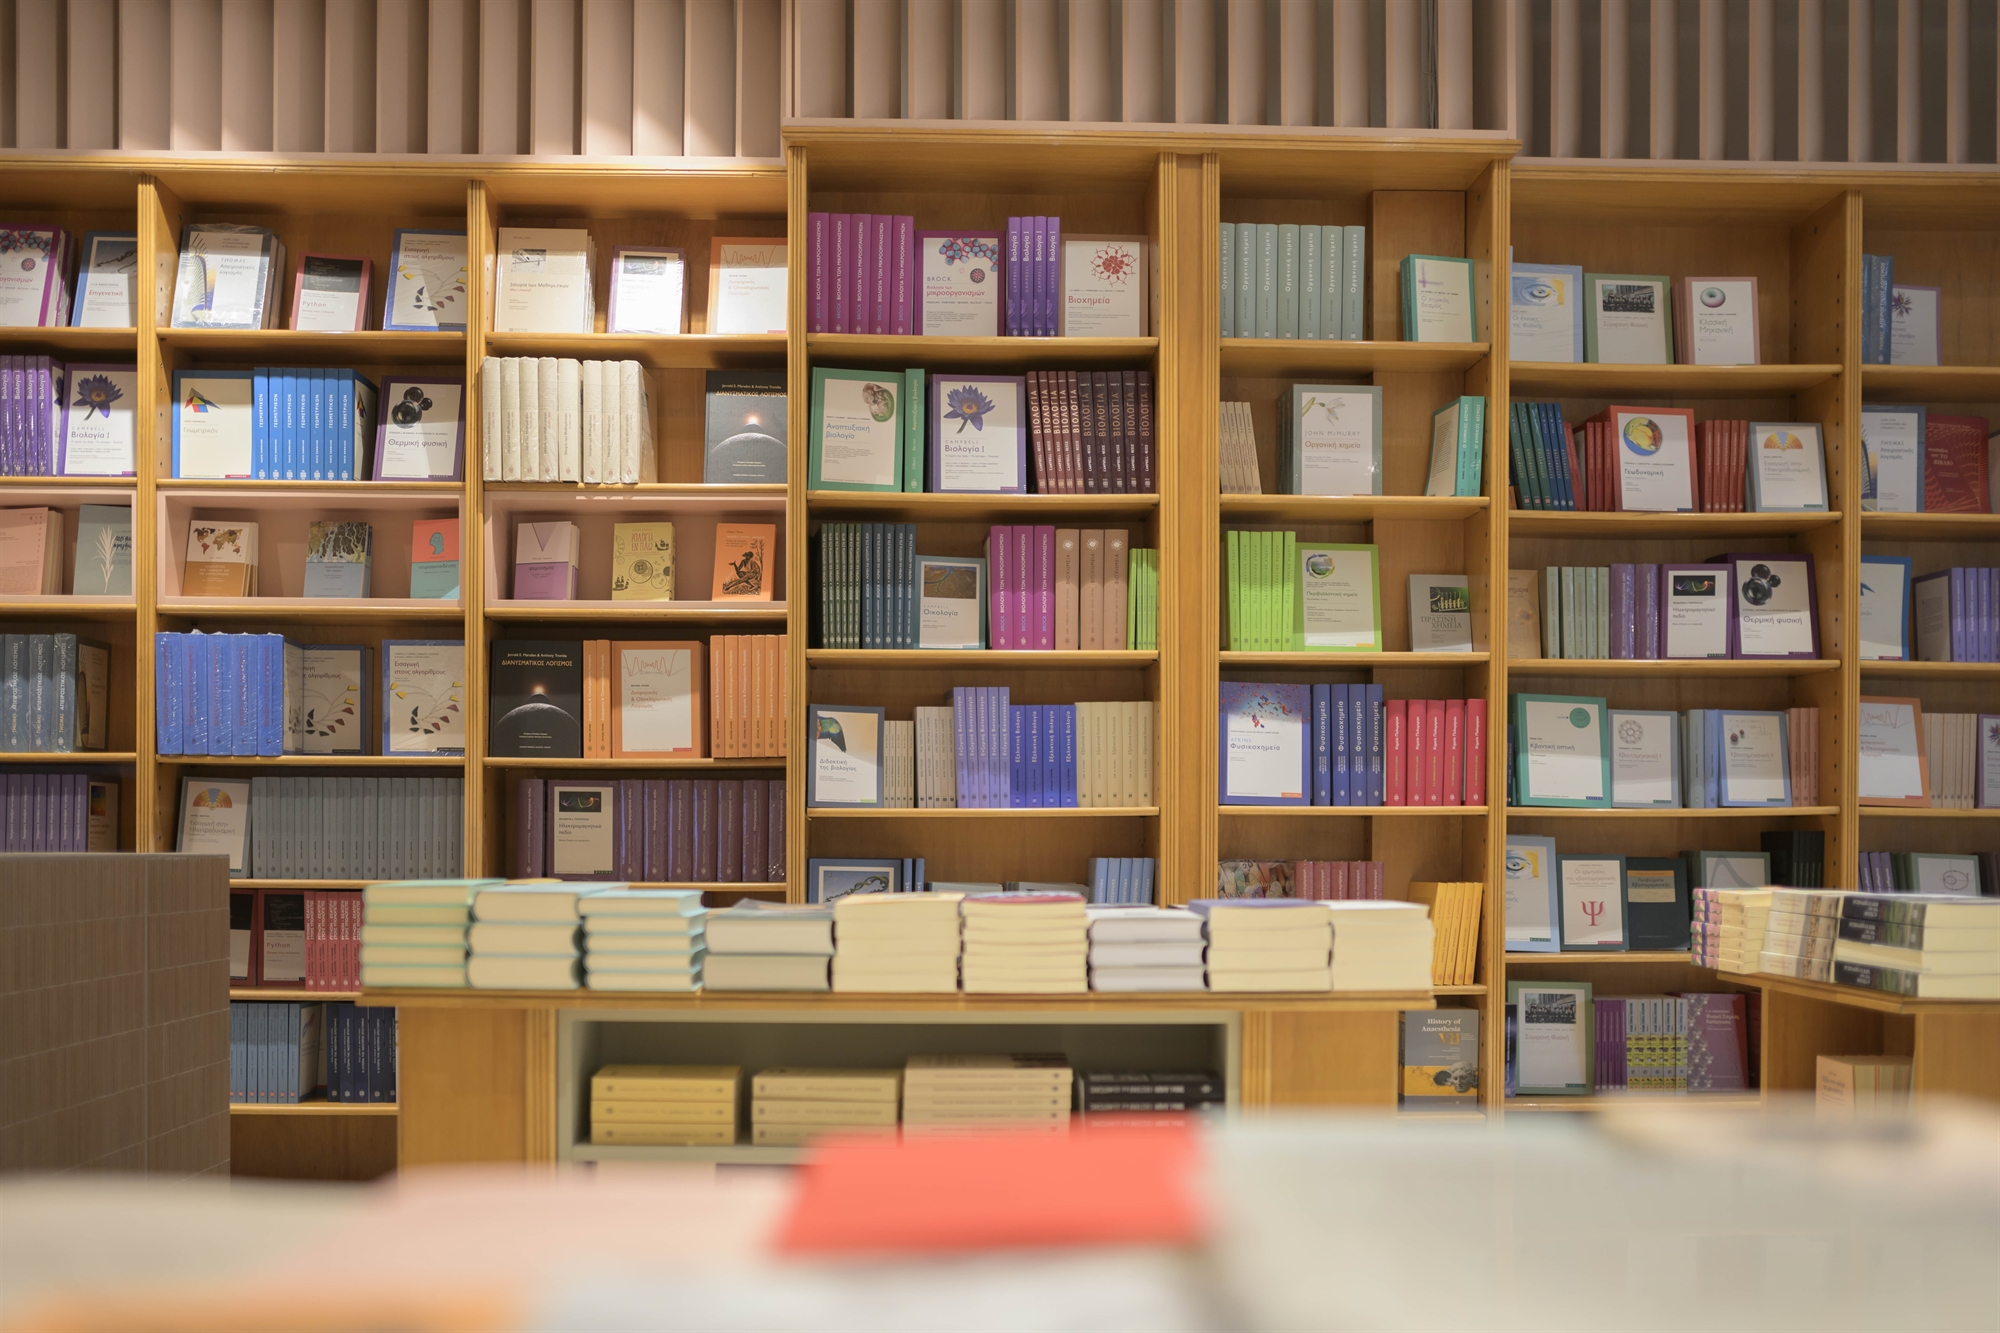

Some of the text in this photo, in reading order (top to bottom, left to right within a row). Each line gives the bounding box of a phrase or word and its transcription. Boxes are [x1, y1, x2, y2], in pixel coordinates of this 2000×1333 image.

[1068, 296, 1110, 305] Βιοχημεία
[1699, 319, 1727, 327] Κλασική
[1699, 326, 1733, 334] Μηχανική
[1041, 390, 1051, 433] ΒΙΟΛΟΓΙΑ
[1082, 393, 1091, 436] ΒΙΟΛΟΓΙΑ
[826, 423, 870, 432] Αναπτυξιακή
[71, 431, 104, 439] Βιολογία
[826, 431, 854, 440] βιολογία
[388, 439, 447, 448] Θερμική φυσική
[1305, 441, 1360, 449] Οργανική χημεία
[945, 445, 979, 454] Βιολογία
[1624, 467, 1664, 477] Γεωδυναμική
[923, 609, 958, 617] Οικολογία
[1743, 615, 1802, 625] Θερμική φυσική
[1230, 743, 1280, 751] Φυσικοχημεία
[1581, 901, 1604, 926] Ψ
[1438, 1033, 1460, 1044] VII
